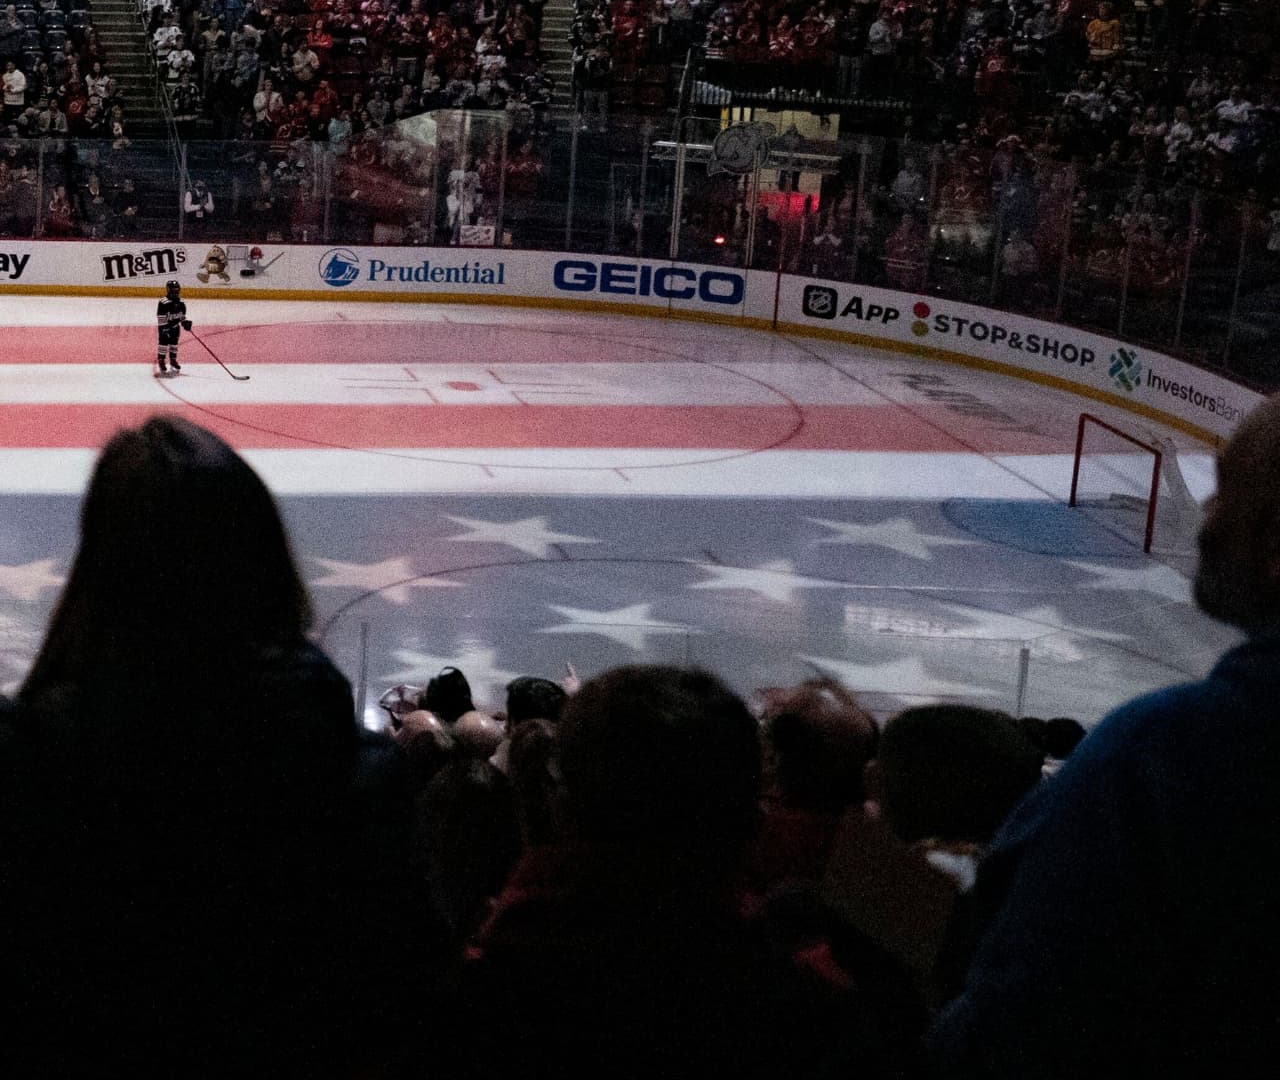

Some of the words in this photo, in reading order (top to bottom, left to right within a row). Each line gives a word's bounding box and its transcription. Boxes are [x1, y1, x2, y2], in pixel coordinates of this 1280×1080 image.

[367, 259, 505, 285] Prudential
[553, 260, 744, 305] GEICO
[933, 313, 1096, 368] STOP&SHOP
